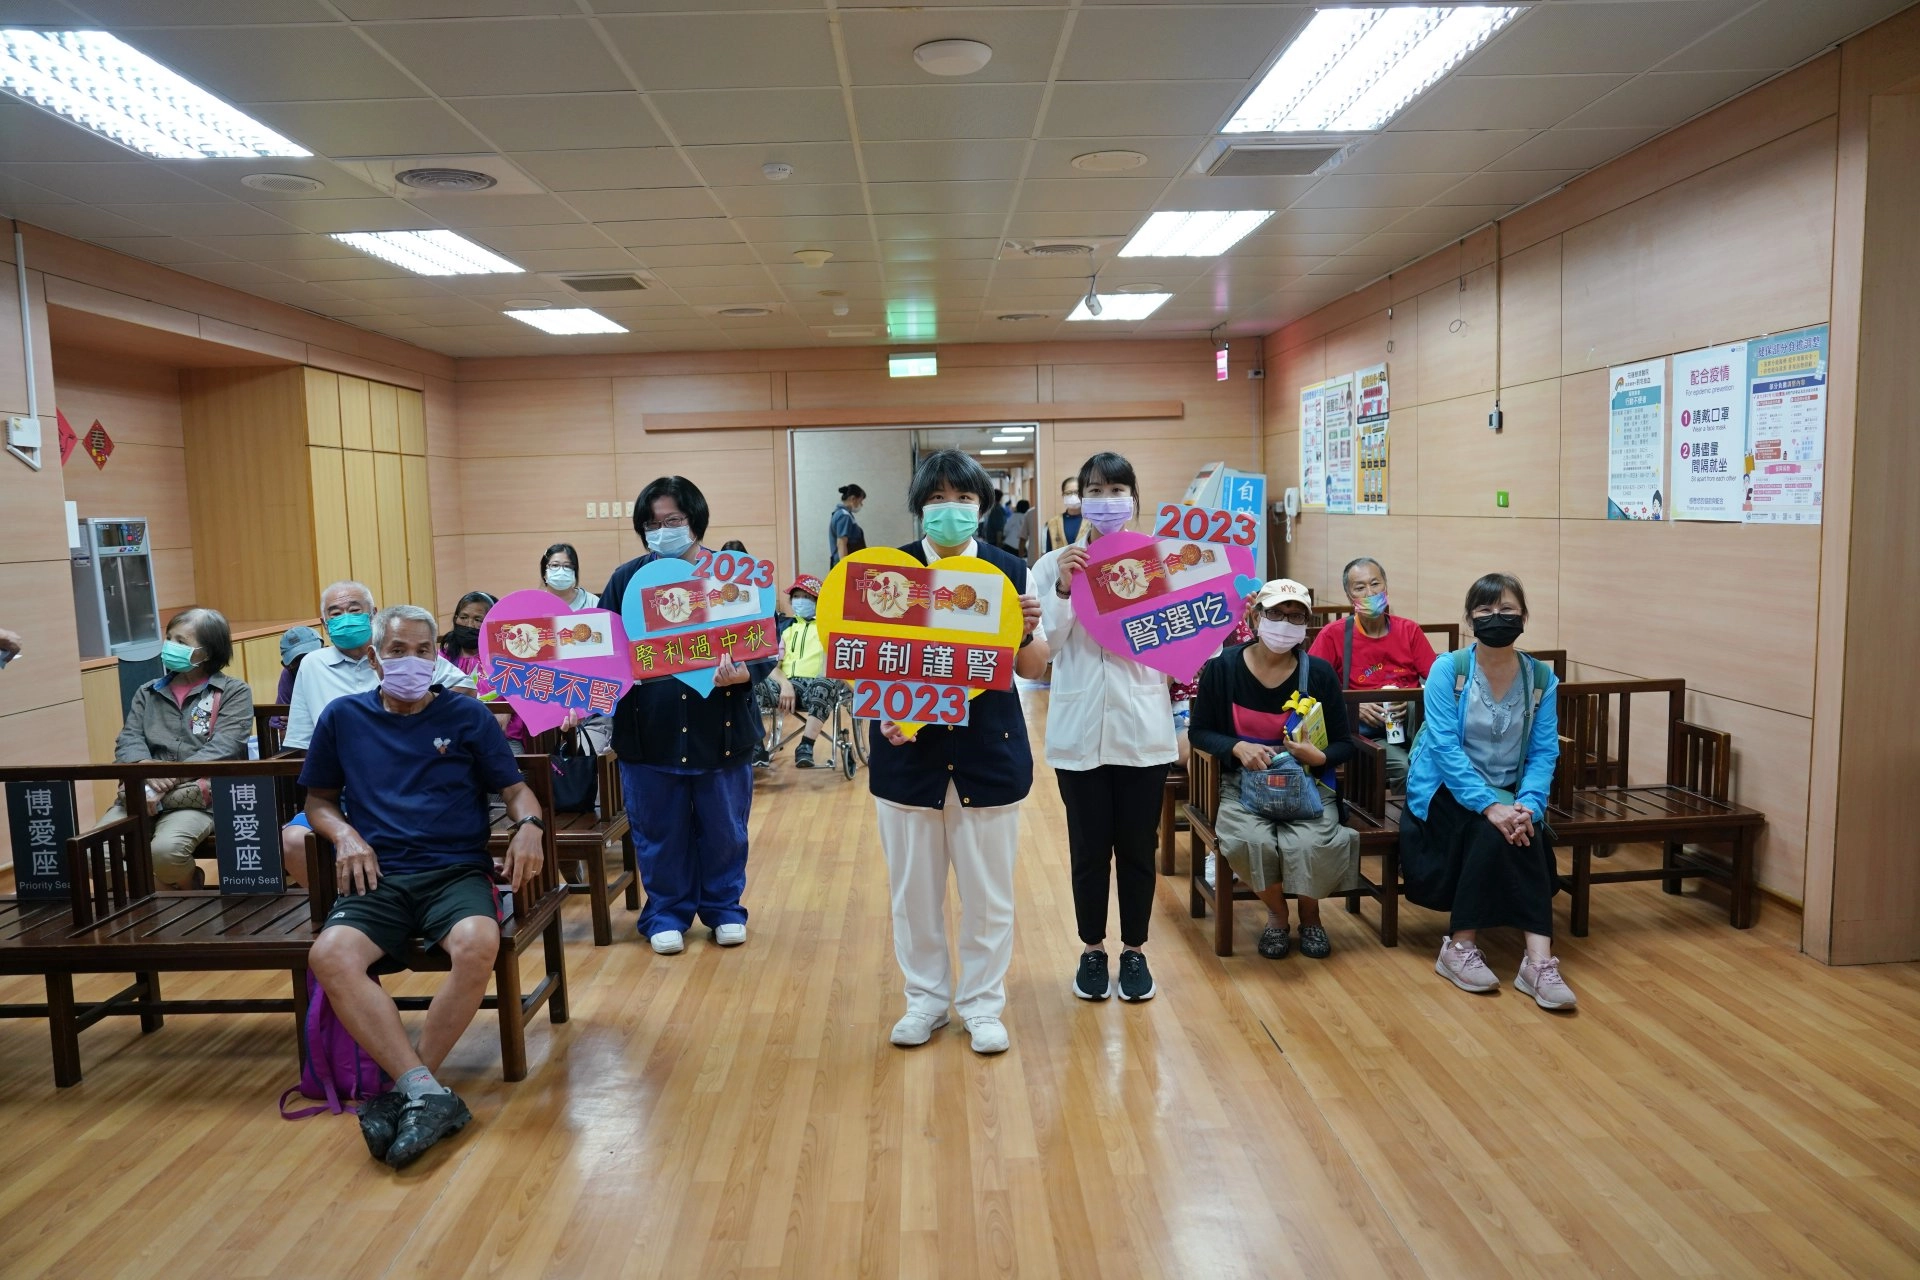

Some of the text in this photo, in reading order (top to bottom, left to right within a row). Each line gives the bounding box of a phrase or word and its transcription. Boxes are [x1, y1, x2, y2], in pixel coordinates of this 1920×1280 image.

[1690, 365, 1730, 386] 配合疫情
[1693, 388, 1711, 396] epidemic
[1712, 385, 1734, 394] prevention
[1693, 407, 1730, 424] 請戴口罩
[1691, 458, 1728, 473] 間隔就坐
[1692, 442, 1719, 457] 請儘量
[1156, 504, 1256, 546] 2023
[691, 550, 775, 588] 2023
[1125, 595, 1229, 650] 腎選吃
[635, 623, 772, 670] 腎利過中秋
[834, 637, 998, 682] 節制謹腎
[491, 660, 621, 714] 不得不腎
[854, 680, 966, 723] 2023
[25, 788, 59, 876] 博愛座
[229, 784, 263, 871] 博愛座
[19, 881, 71, 891] Priority Sea
[223, 876, 279, 886] Priority Seat
